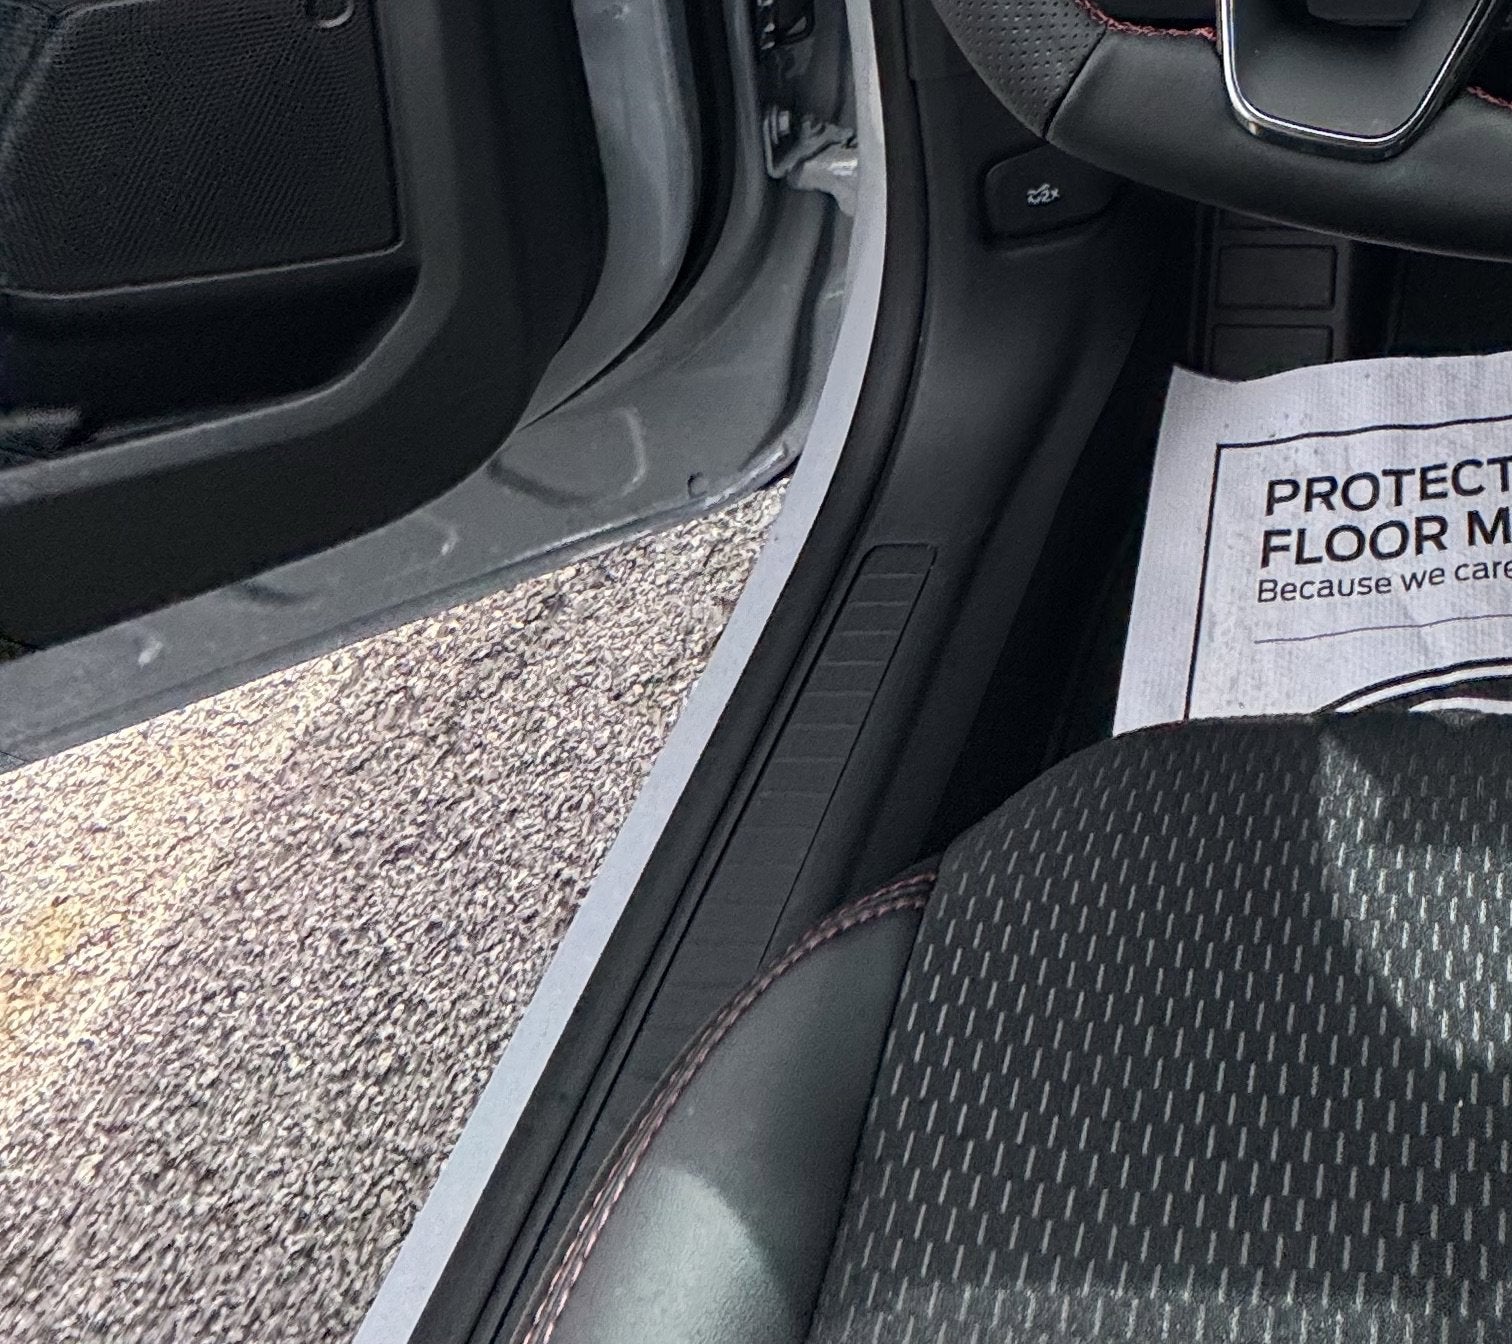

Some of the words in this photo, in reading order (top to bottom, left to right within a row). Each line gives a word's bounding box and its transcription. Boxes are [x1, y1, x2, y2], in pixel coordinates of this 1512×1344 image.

[1260, 515, 1449, 568] FLOOR
[1257, 574, 1392, 604] Because
[1401, 567, 1446, 593] we
